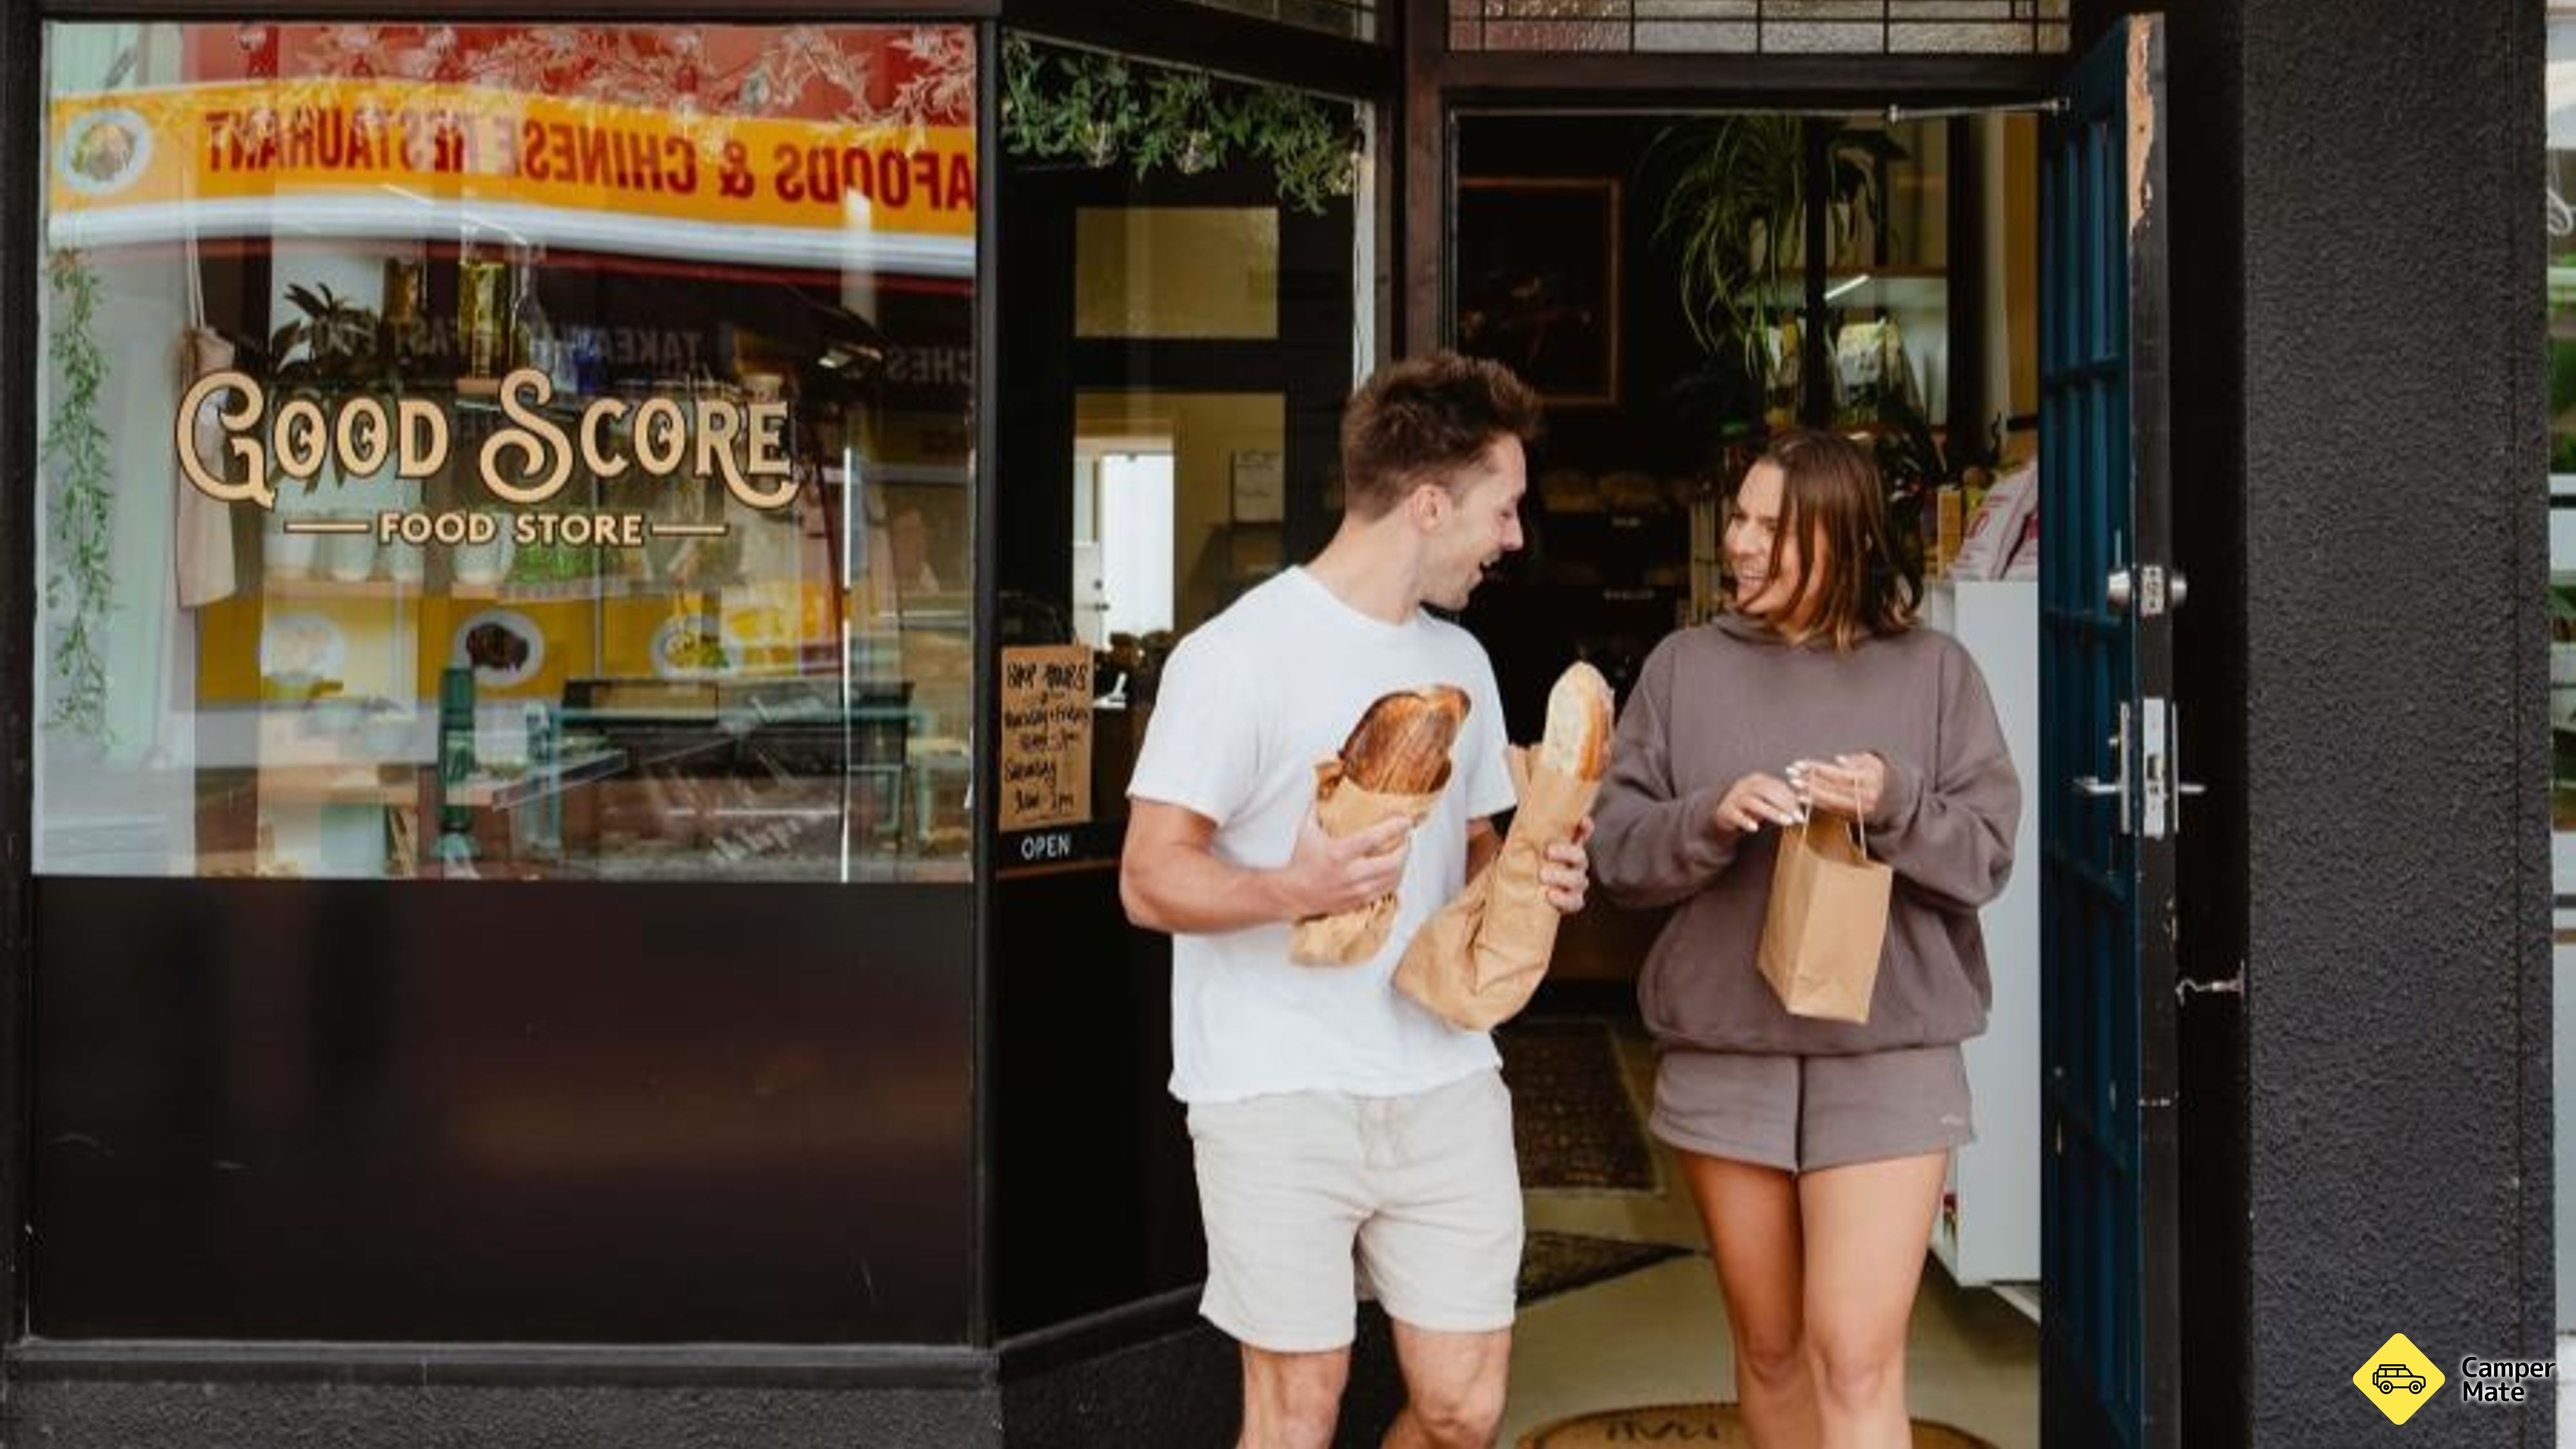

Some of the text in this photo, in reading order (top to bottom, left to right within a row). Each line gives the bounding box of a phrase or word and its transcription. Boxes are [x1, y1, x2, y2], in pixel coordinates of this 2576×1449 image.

[174, 368, 799, 509] GOOD SCORE
[379, 513, 643, 547] FOOD STORE
[1021, 835, 1071, 860] OPEN
